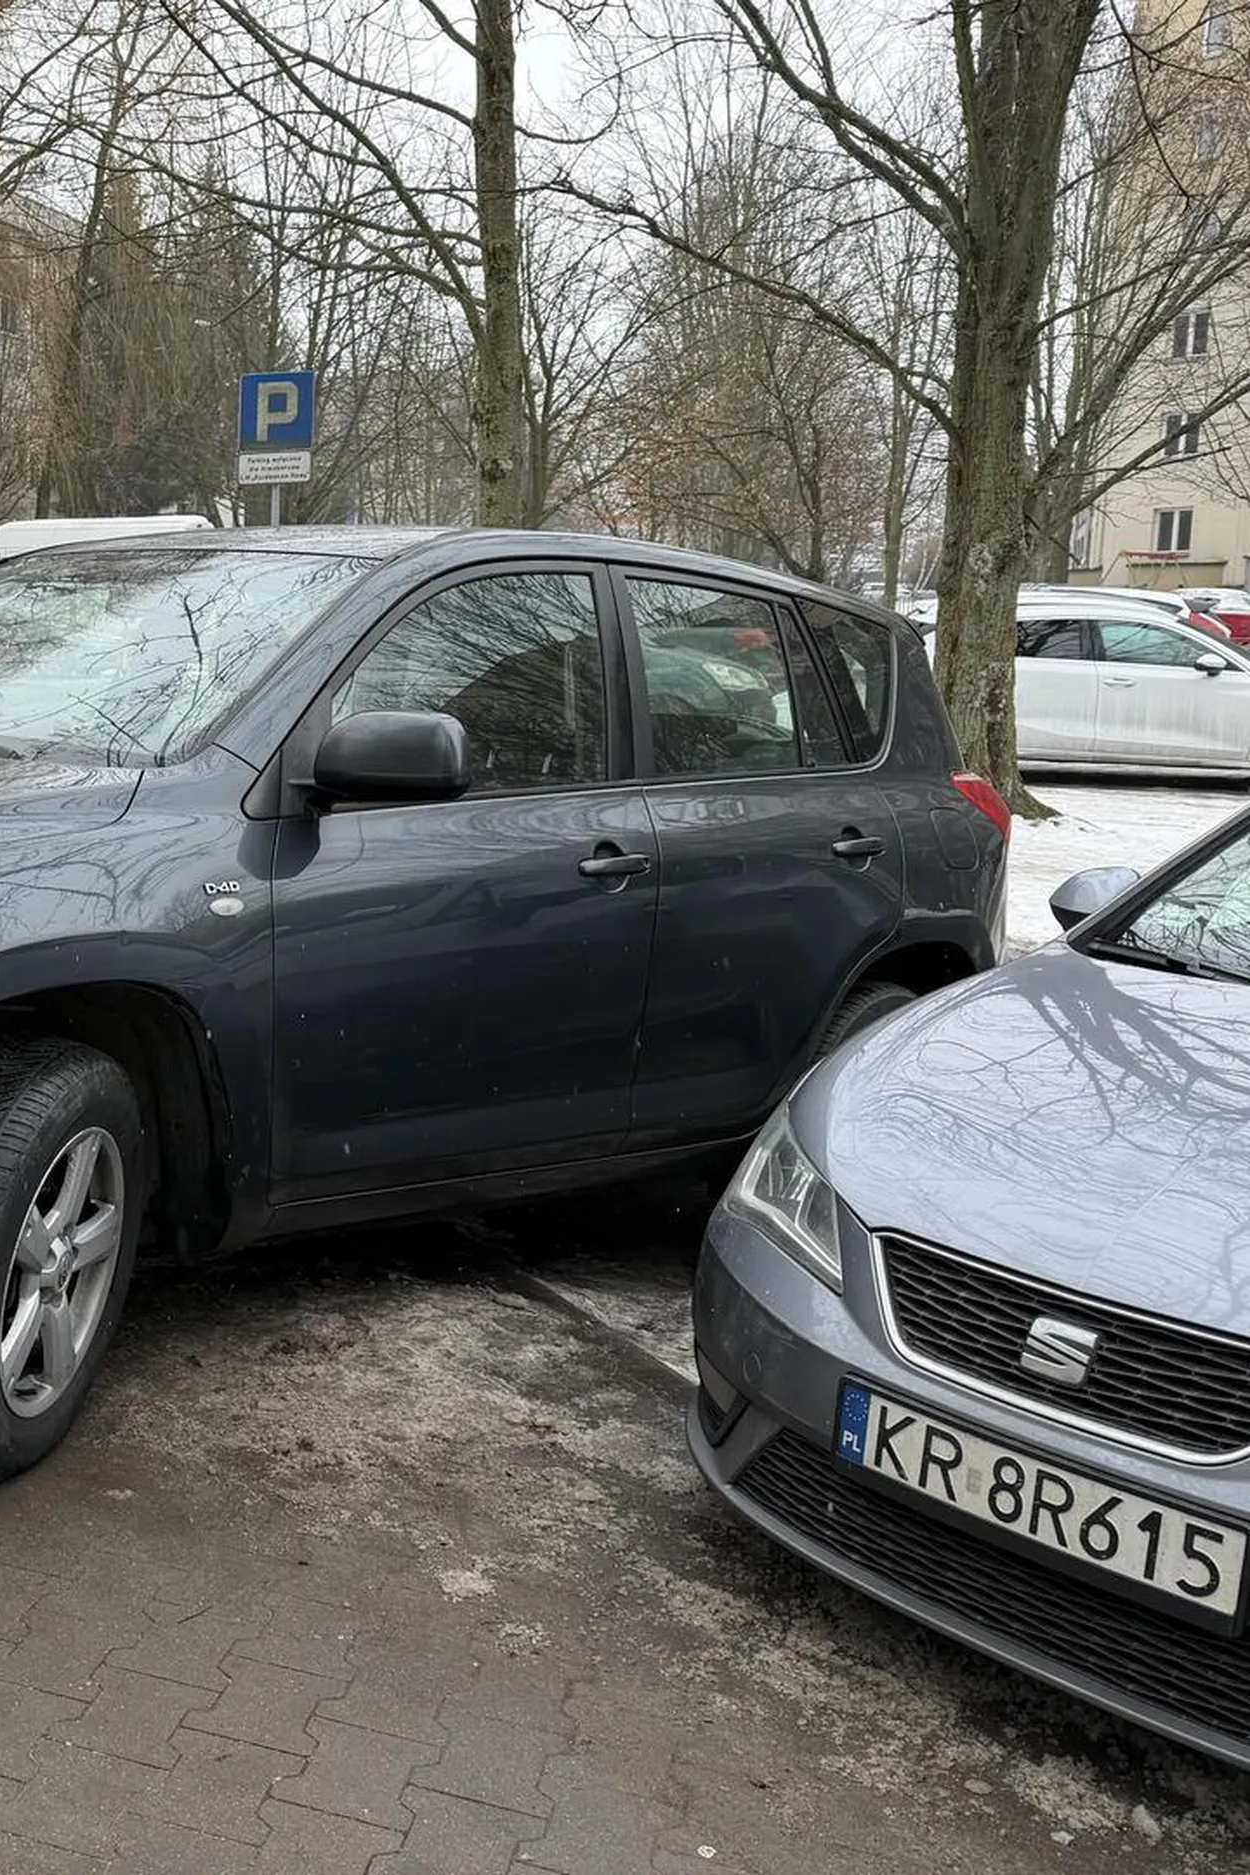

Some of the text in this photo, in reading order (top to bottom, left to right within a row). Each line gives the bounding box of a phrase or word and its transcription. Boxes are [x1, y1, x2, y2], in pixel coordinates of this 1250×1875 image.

[257, 381, 299, 442] P
[842, 1430, 862, 1454] PL
[874, 1405, 1225, 1598] KR 8R615
